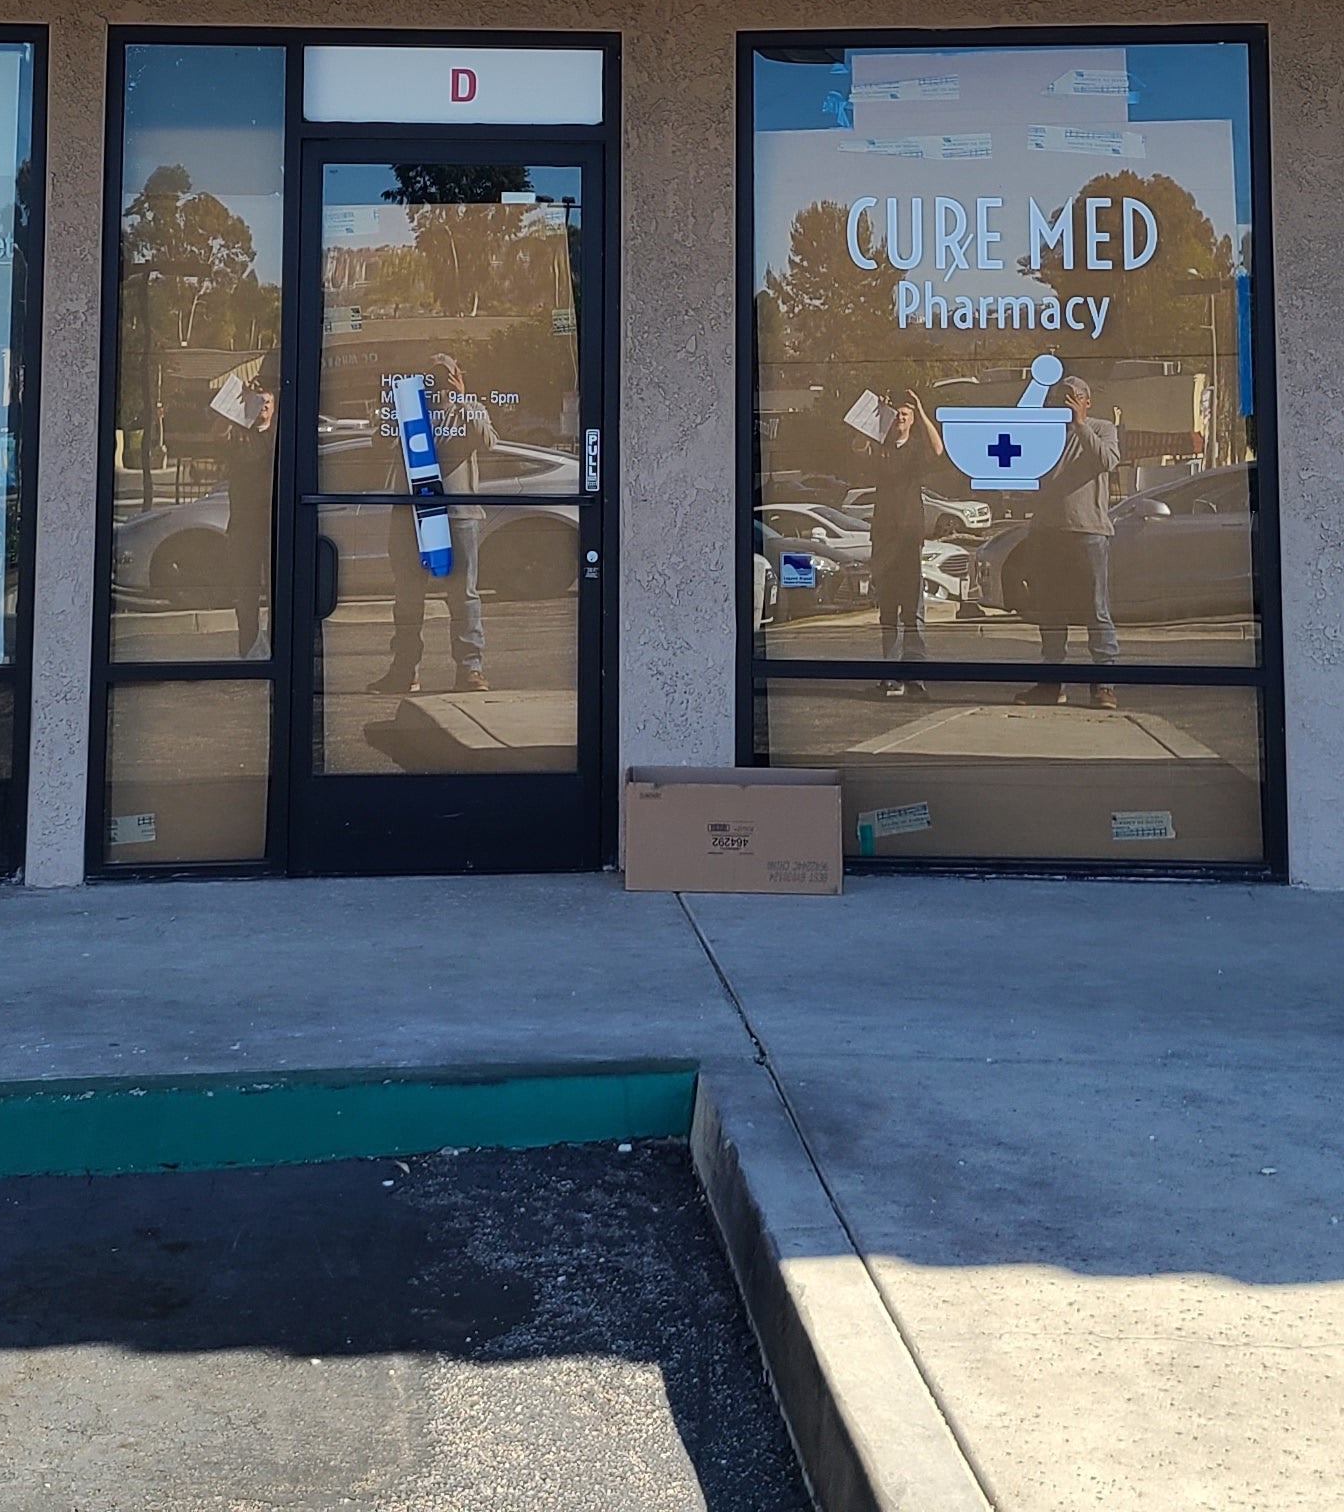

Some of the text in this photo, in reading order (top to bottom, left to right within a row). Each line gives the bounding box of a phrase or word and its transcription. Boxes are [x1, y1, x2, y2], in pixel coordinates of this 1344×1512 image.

[450, 68, 478, 103] D
[845, 196, 1159, 282] CURE MED
[897, 280, 1110, 340] Pharmacy
[380, 407, 399, 420] Sa
[449, 391, 477, 404] 9am
[491, 391, 519, 406] 5pm
[380, 424, 467, 437] Su losed
[587, 434, 598, 476] PULL
